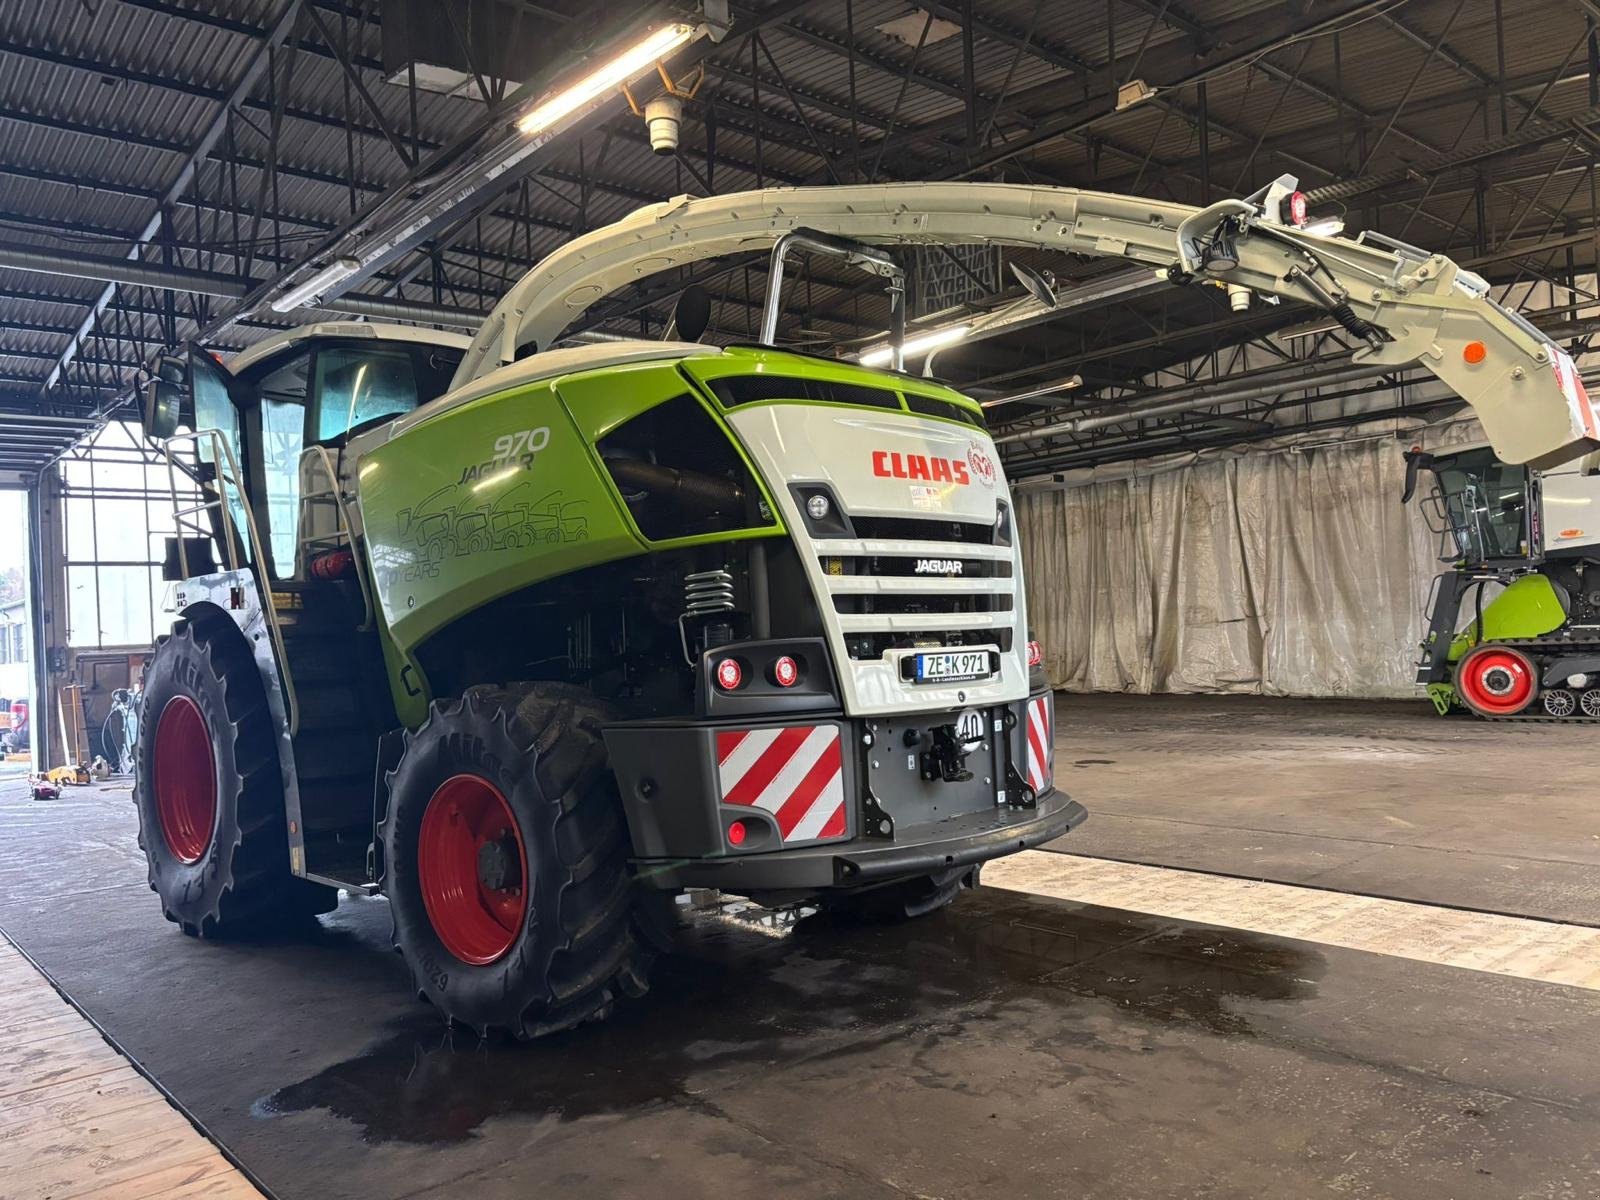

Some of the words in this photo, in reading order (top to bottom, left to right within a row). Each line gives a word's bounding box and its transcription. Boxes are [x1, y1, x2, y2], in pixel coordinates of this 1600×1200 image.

[492, 426, 551, 460] 970
[872, 451, 970, 485] CLAAS
[914, 559, 963, 574] JAGUAR
[928, 656, 944, 675] ZE
[951, 655, 960, 674] K
[962, 654, 984, 673] 971
[960, 714, 979, 740] 40
